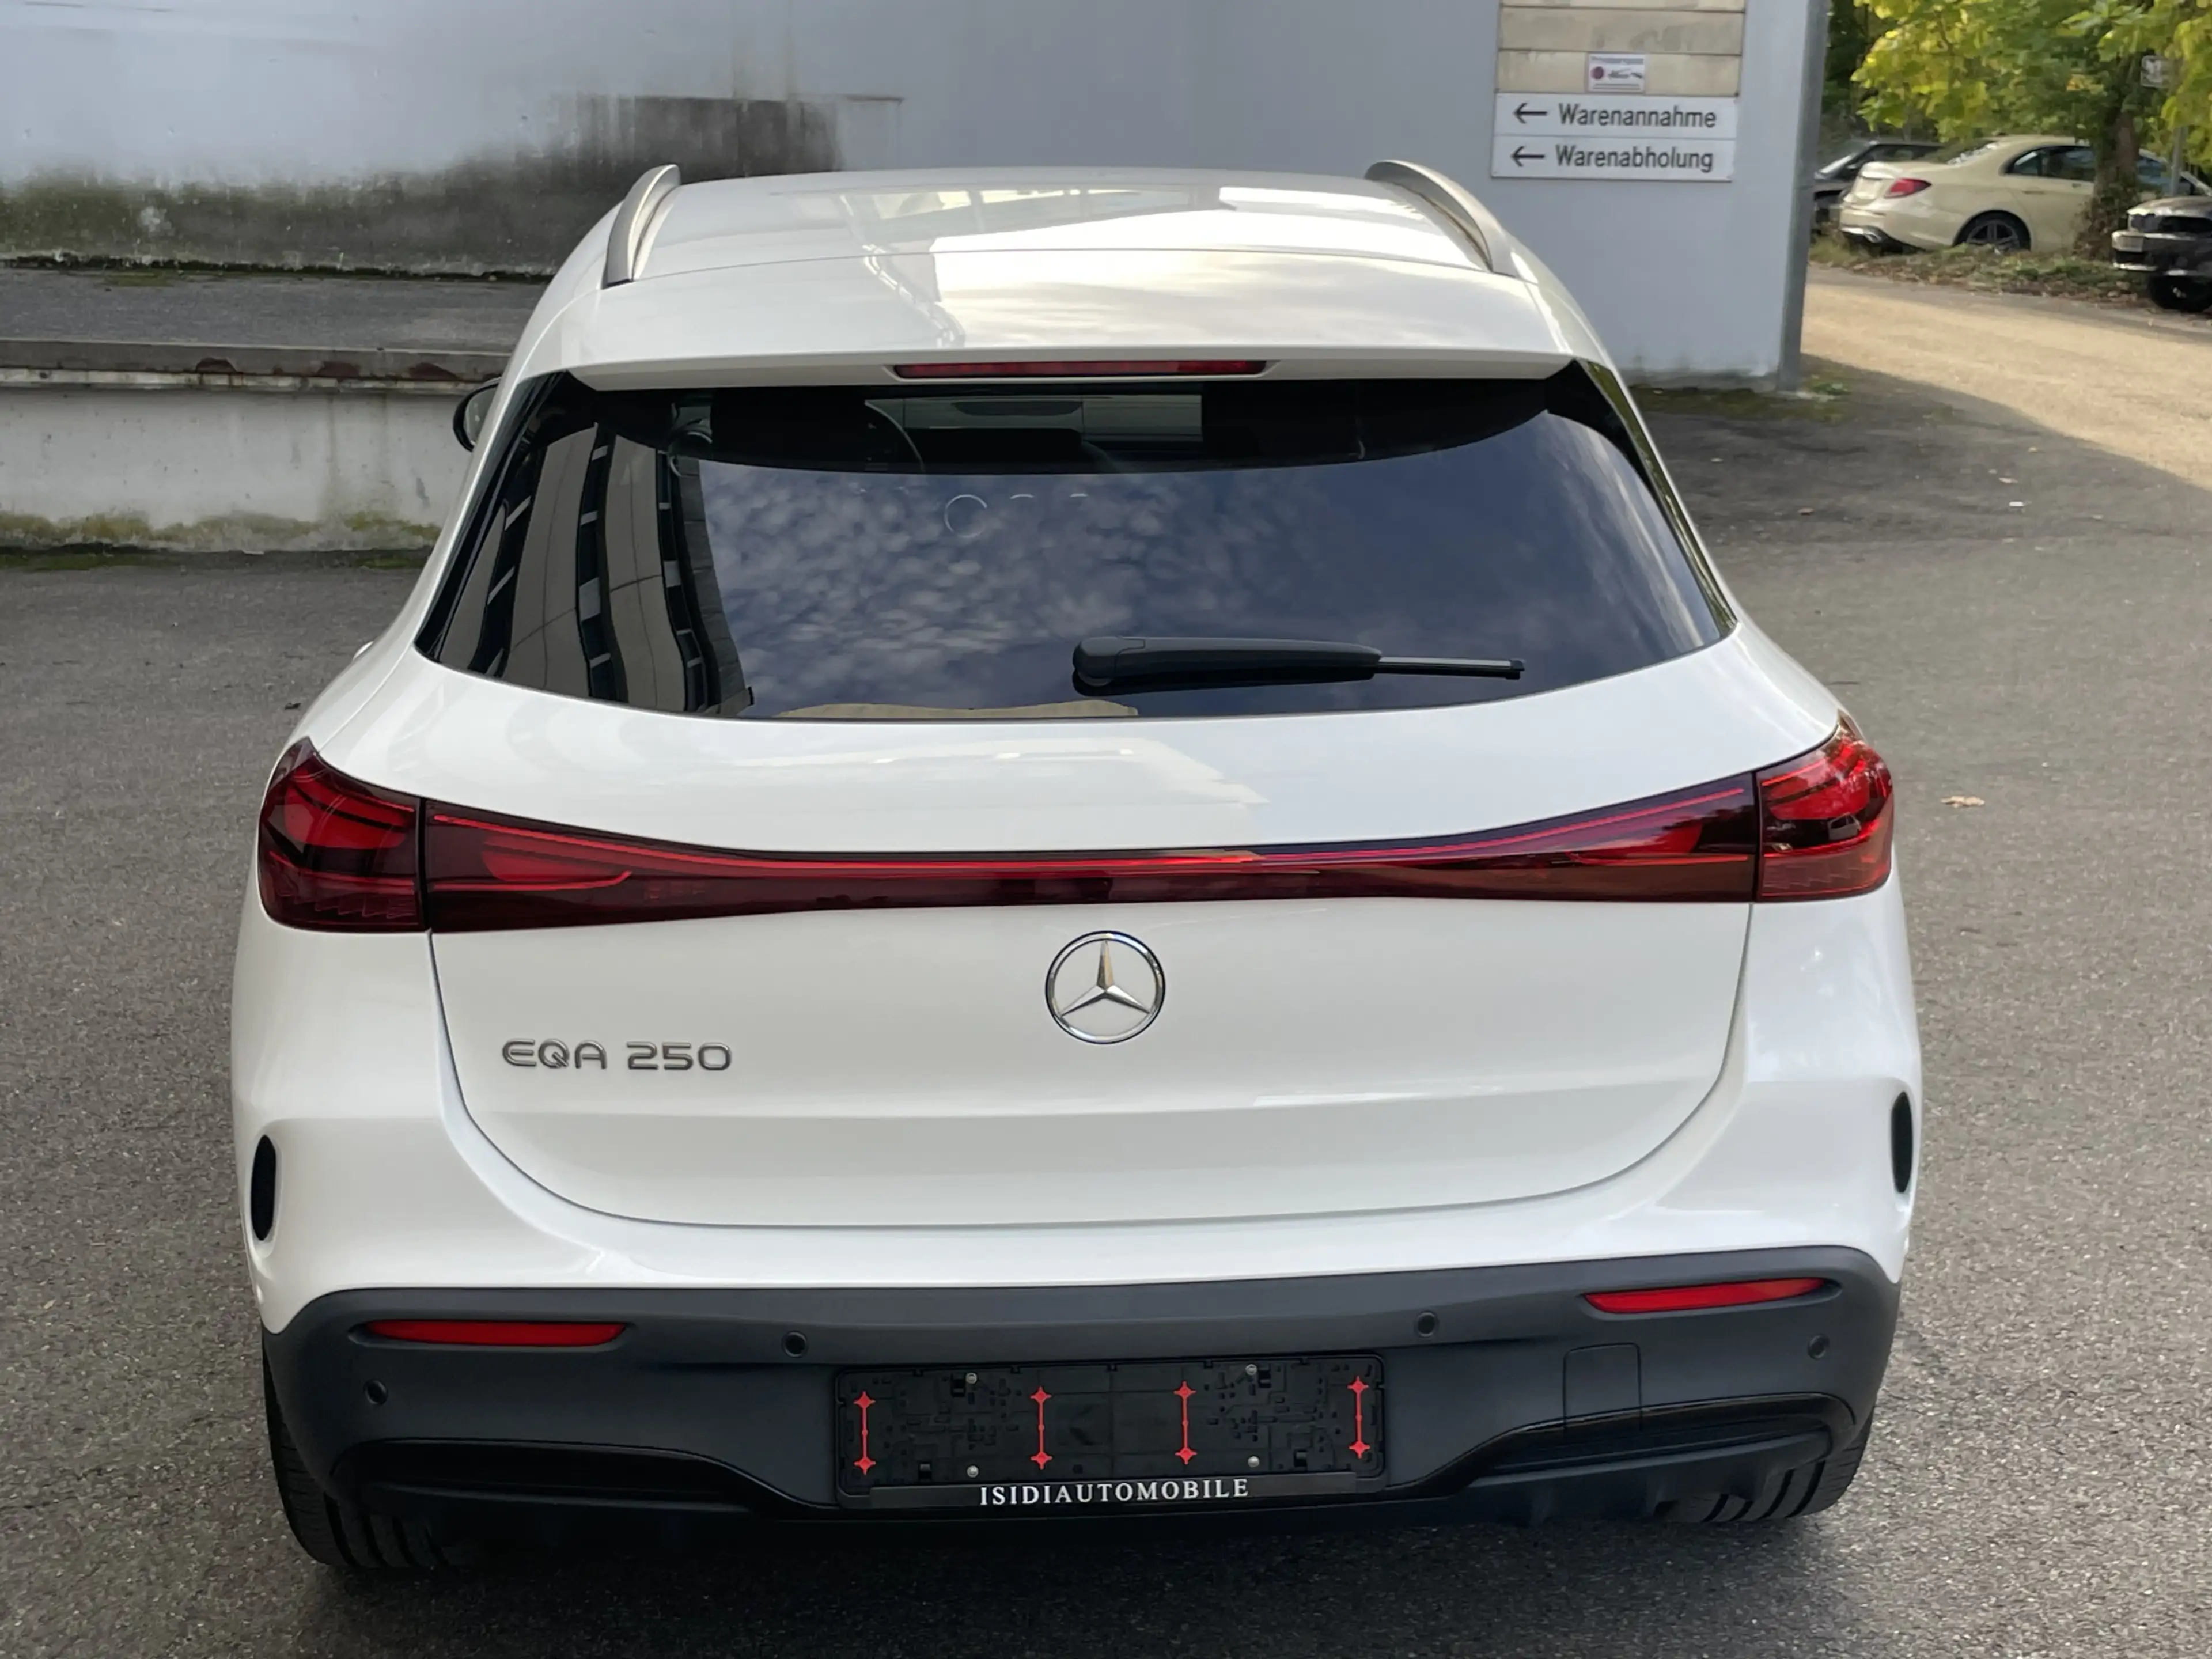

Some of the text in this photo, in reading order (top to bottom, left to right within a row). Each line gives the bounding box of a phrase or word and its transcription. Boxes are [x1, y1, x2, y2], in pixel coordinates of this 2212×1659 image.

[1558, 103, 1717, 128] Warenannahme
[1555, 144, 1713, 173] Warenabholung
[502, 1038, 732, 1071] EQA 250
[979, 1478, 1249, 1505] ISIDIAUTOMOBILE
